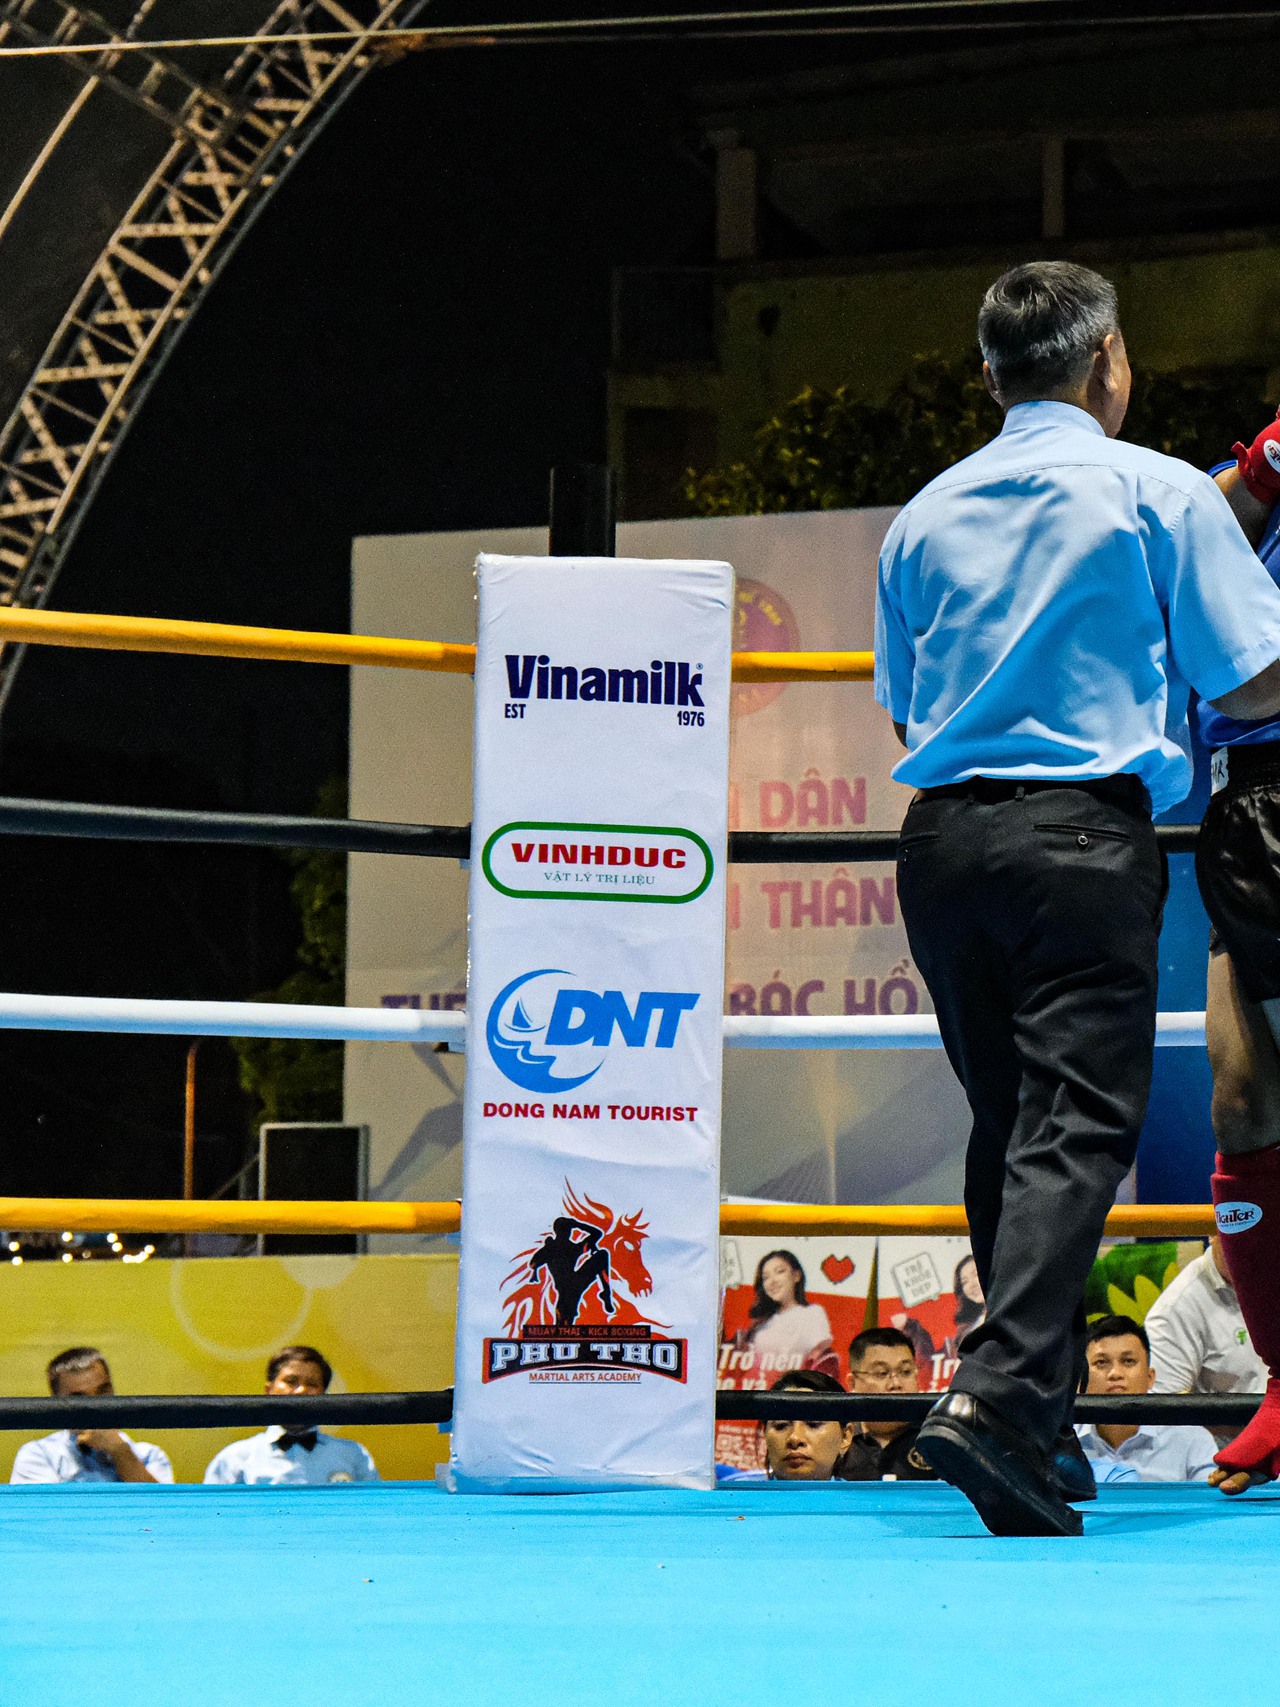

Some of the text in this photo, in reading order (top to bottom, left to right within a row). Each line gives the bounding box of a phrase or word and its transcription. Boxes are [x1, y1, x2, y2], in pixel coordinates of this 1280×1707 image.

[505, 654, 705, 707] Vinamilk
[504, 704, 705, 727] EST 1976
[759, 768, 866, 828] DÂN
[511, 843, 686, 868] VINHDUC
[544, 871, 571, 883] VẬT
[761, 867, 895, 930] THÂN
[545, 989, 700, 1048] DNT
[483, 1102, 699, 1122] DONG NAM TOURIST
[611, 1327, 646, 1336] BOXING
[492, 1342, 678, 1372] PHU THO
[529, 1373, 641, 1382] MARTIAL ARTS ACADEMY
